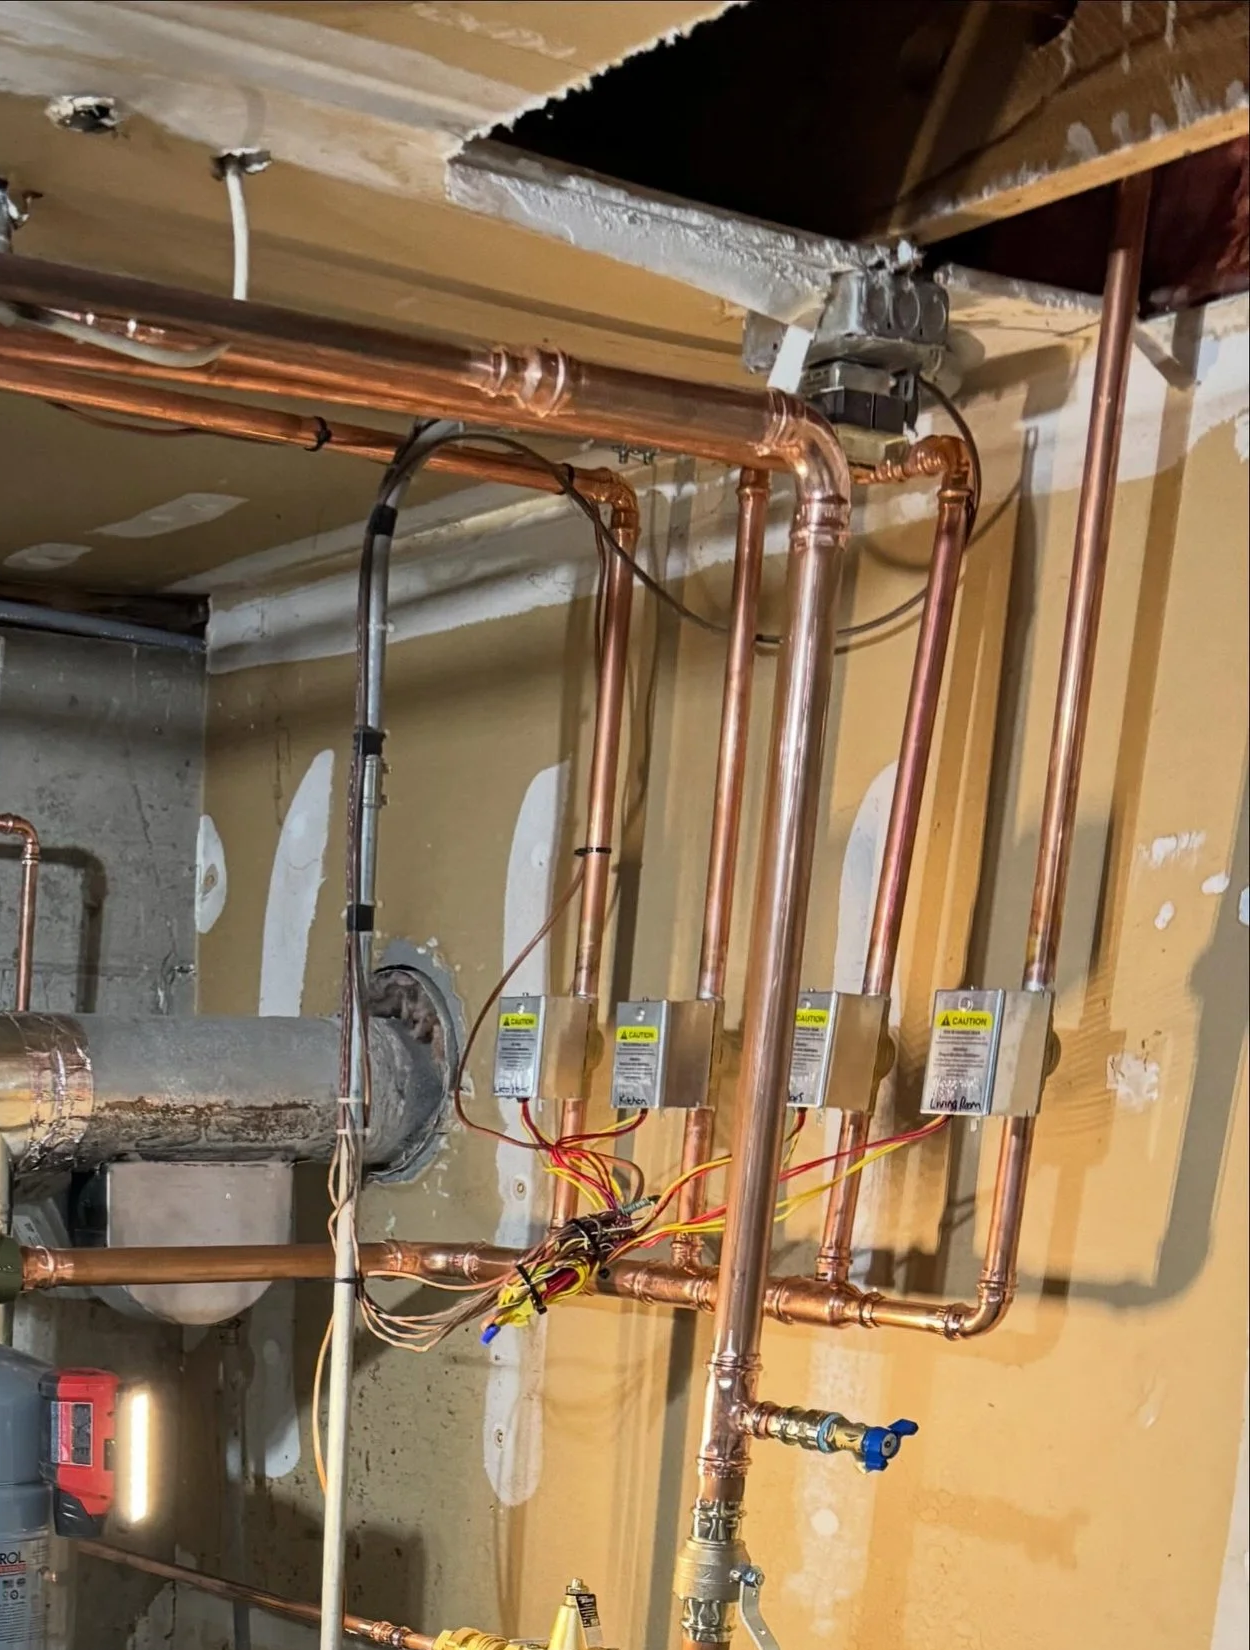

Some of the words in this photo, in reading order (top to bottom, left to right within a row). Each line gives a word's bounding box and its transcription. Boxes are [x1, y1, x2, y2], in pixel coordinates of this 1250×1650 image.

[510, 1016, 535, 1027] CAUTION
[796, 1013, 827, 1024] CAUTION
[952, 1017, 988, 1027] CAUTION
[628, 1030, 654, 1040] CAUTION
[930, 1098, 958, 1112] Living
[959, 1096, 982, 1112] Room
